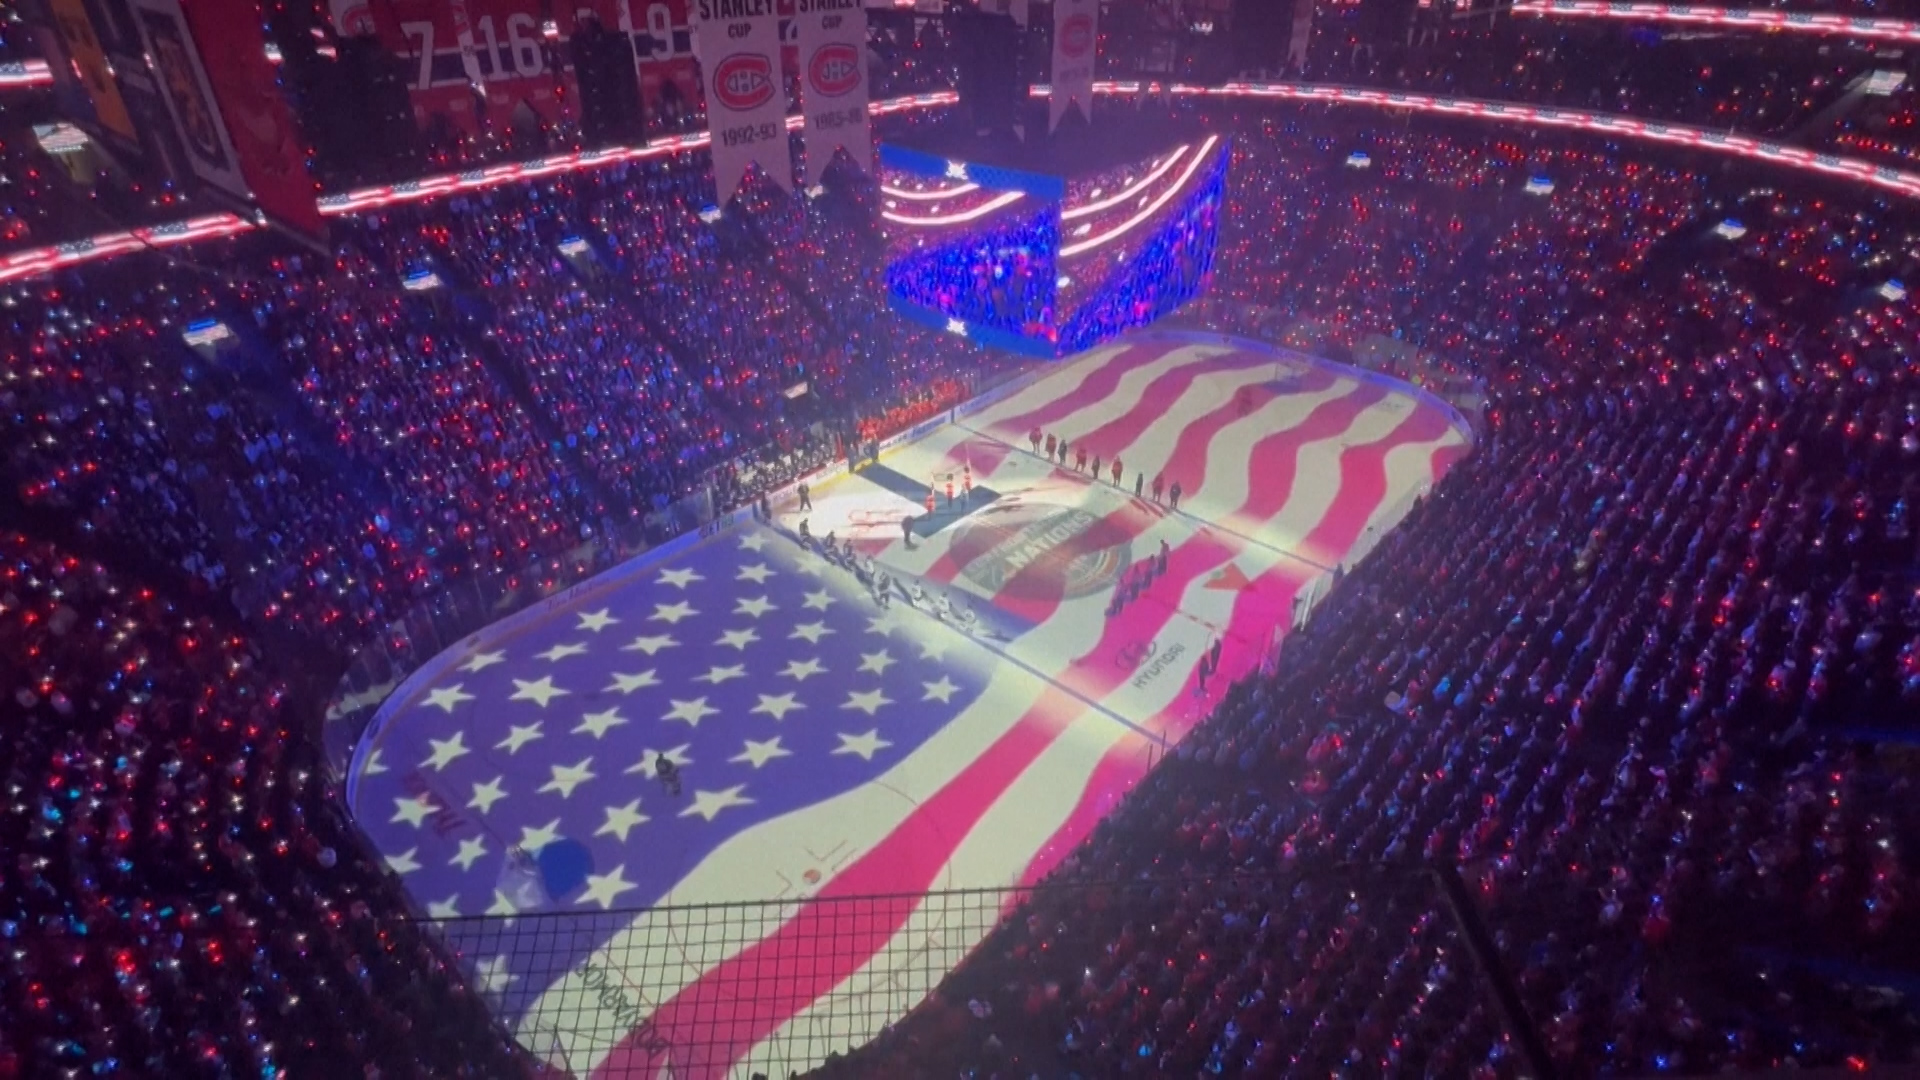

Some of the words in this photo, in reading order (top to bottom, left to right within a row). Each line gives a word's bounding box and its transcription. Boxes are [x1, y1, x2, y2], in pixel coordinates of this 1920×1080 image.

[699, 0, 772, 20] STANLEY
[727, 23, 751, 38] CUP
[821, 15, 843, 29] CUP
[476, 12, 544, 79] 16
[646, 3, 675, 61] 9
[400, 21, 434, 90] 7
[721, 123, 777, 147] 1992-93
[1005, 511, 1094, 570] NATIONS
